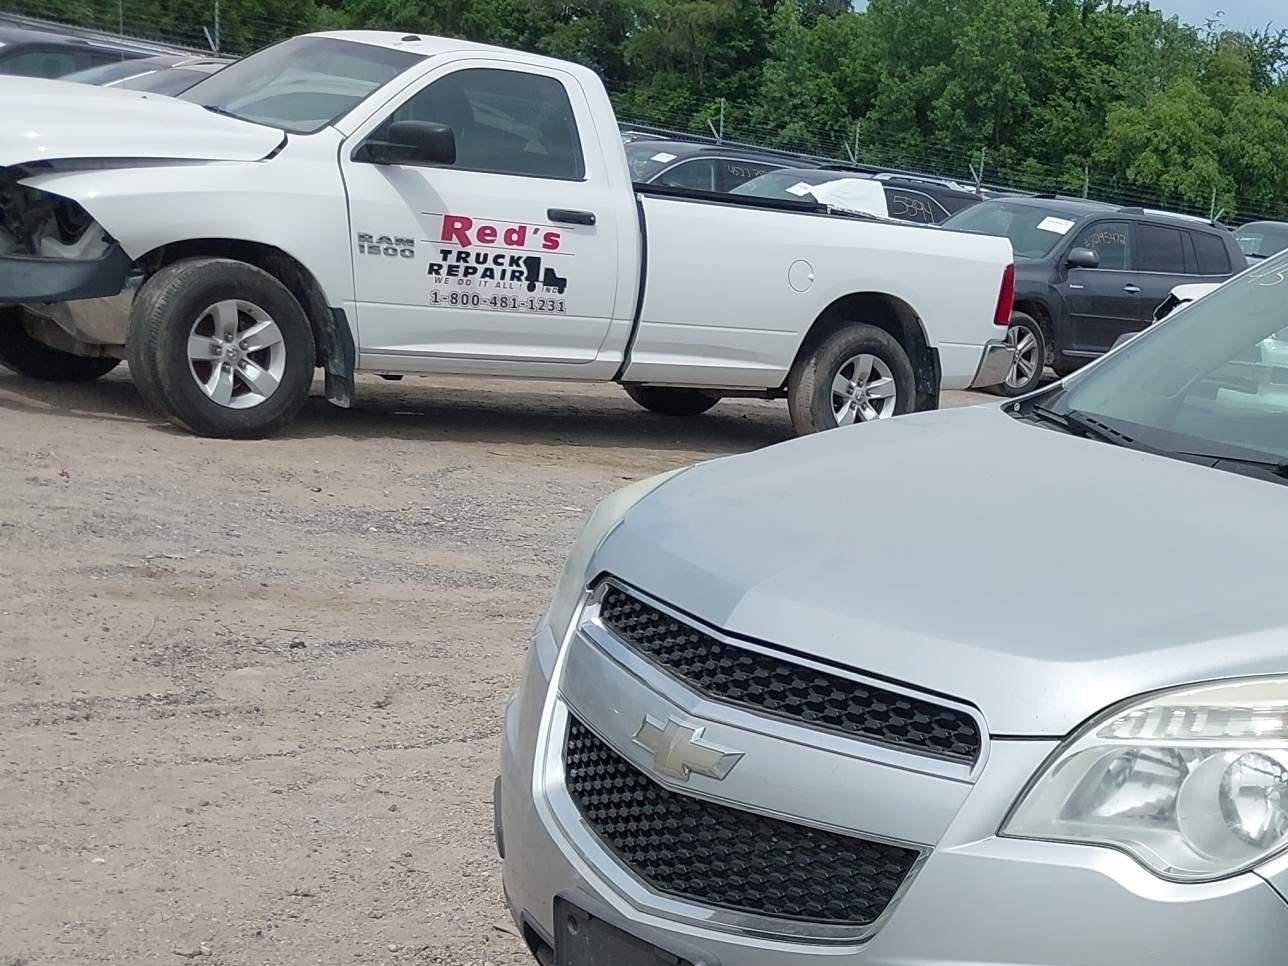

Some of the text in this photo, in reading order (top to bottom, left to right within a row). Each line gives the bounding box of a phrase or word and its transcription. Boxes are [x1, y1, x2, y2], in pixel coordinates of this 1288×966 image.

[358, 232, 415, 247] RAM
[440, 214, 561, 250] Red's
[358, 244, 415, 258] 1500
[439, 249, 524, 267] TRUCK
[427, 263, 526, 282] REPAIR
[434, 276, 449, 285] WE
[479, 280, 488, 288] IT
[430, 290, 566, 312] 1-800-481-1231
